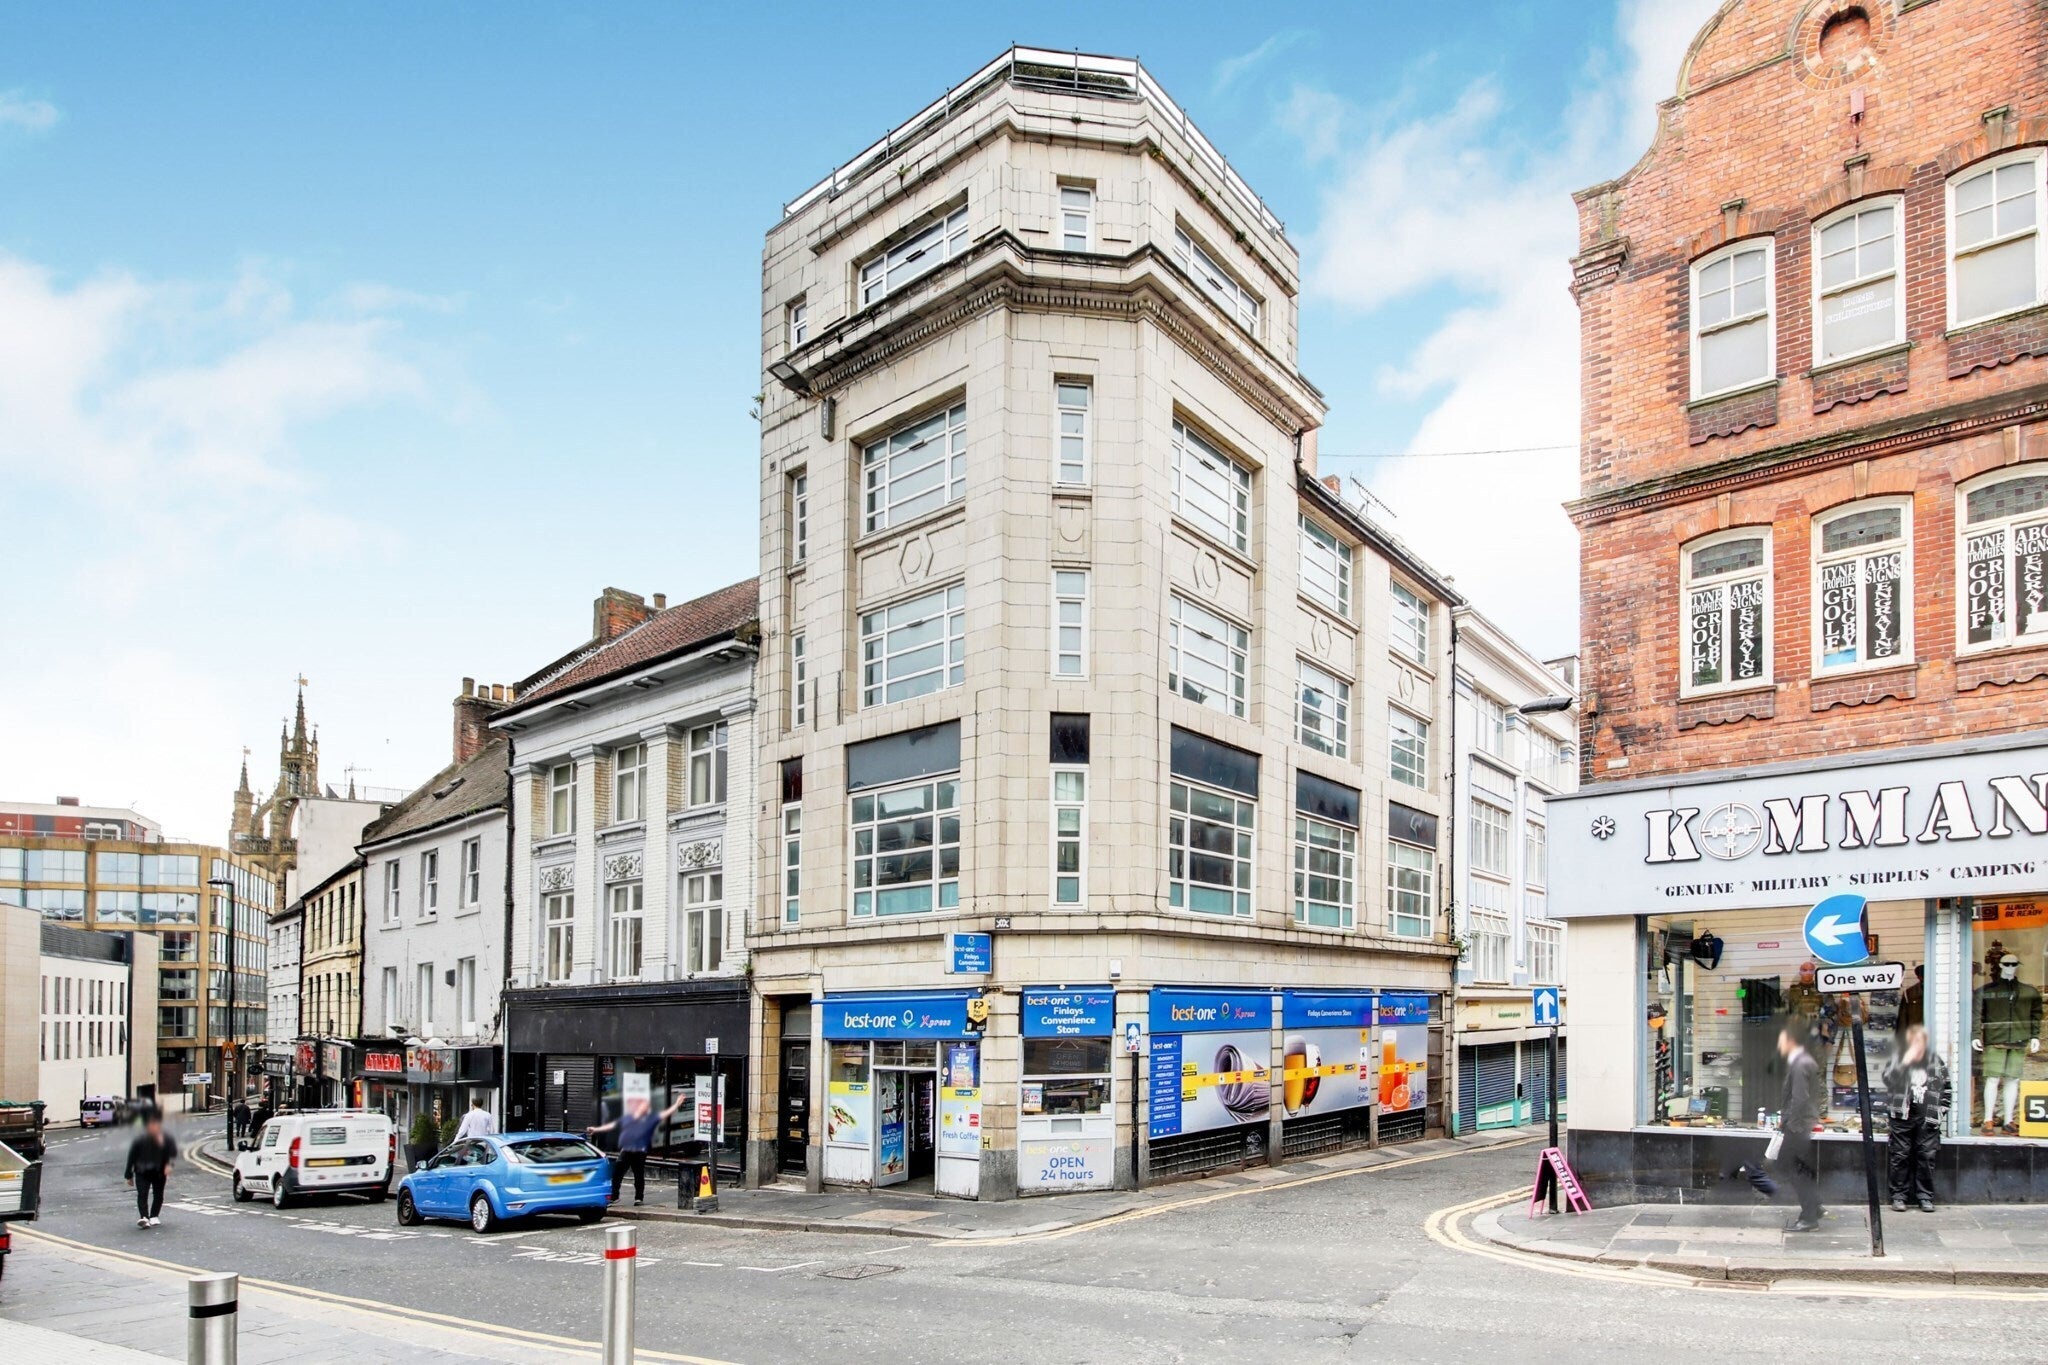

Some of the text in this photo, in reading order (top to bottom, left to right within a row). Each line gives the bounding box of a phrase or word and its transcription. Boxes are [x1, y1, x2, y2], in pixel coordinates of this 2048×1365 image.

[1968, 532, 2004, 553] TYNE
[2015, 539, 2048, 557] SIGN
[1968, 545, 2005, 563] TROPHIES
[1823, 563, 1857, 580] TYNE
[1866, 554, 1901, 572] ABC
[1823, 575, 1857, 590] TROPHIES
[1865, 564, 1901, 585] SIGNS
[1692, 589, 1722, 606] TYNE
[1731, 581, 1763, 599] ABC
[1969, 563, 1988, 629] GOLF
[1987, 559, 2005, 623] RUGBY
[1692, 600, 1723, 615] TROPHIES
[1731, 593, 1763, 610] SIGNS
[1824, 589, 1841, 650] GOLF
[1841, 586, 1857, 647] RUGBY
[1875, 581, 1893, 657] ENGRAVING
[1693, 614, 1709, 673] GOLF
[1707, 611, 1722, 670] RUGBY
[1739, 606, 1756, 678] ENGRAVING
[1665, 861, 2036, 898] GENUINE MILITARY SURPLUS CAMPING
[2005, 903, 2036, 911] ALWAYS
[2005, 909, 2043, 918] BE READY
[1823, 972, 1896, 986] One way
[1027, 995, 1070, 1006] best-one
[844, 1011, 897, 1029] best-one
[1053, 1006, 1084, 1017] Finlays
[1172, 1004, 1217, 1021] best-one
[1041, 1016, 1096, 1025] Convenience
[1056, 1025, 1080, 1034] Store
[364, 1053, 403, 1073] ATHENA
[1056, 1052, 1079, 1061] OPEN
[942, 1130, 979, 1141] Fresh Coffee
[1049, 1156, 1085, 1169] OPEN
[1041, 1169, 1094, 1181] 24 hours
